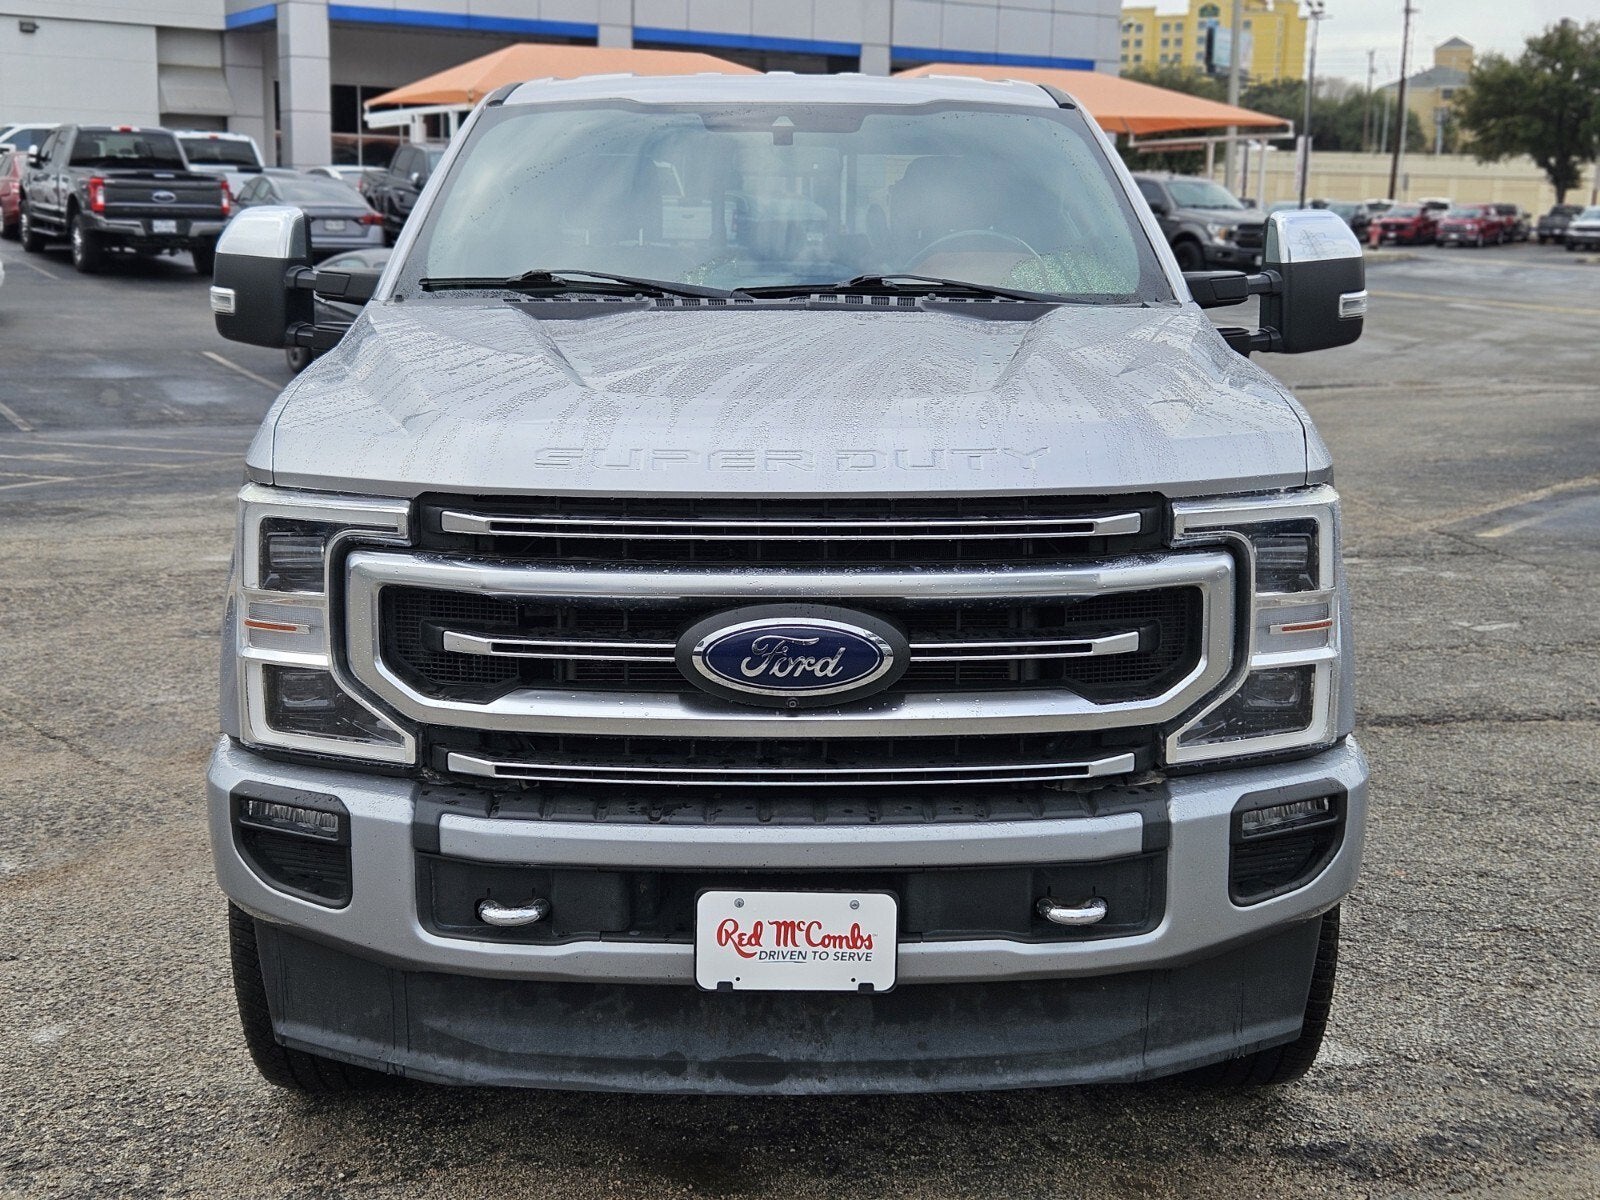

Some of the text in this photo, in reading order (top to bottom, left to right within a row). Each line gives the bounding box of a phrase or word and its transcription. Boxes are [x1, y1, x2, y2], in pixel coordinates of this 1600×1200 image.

[535, 446, 1050, 472] SUPER DUTY
[740, 635, 846, 678] Ford
[716, 918, 874, 959] Red McCombs
[758, 950, 873, 962] DRIVEN TO SERVE
